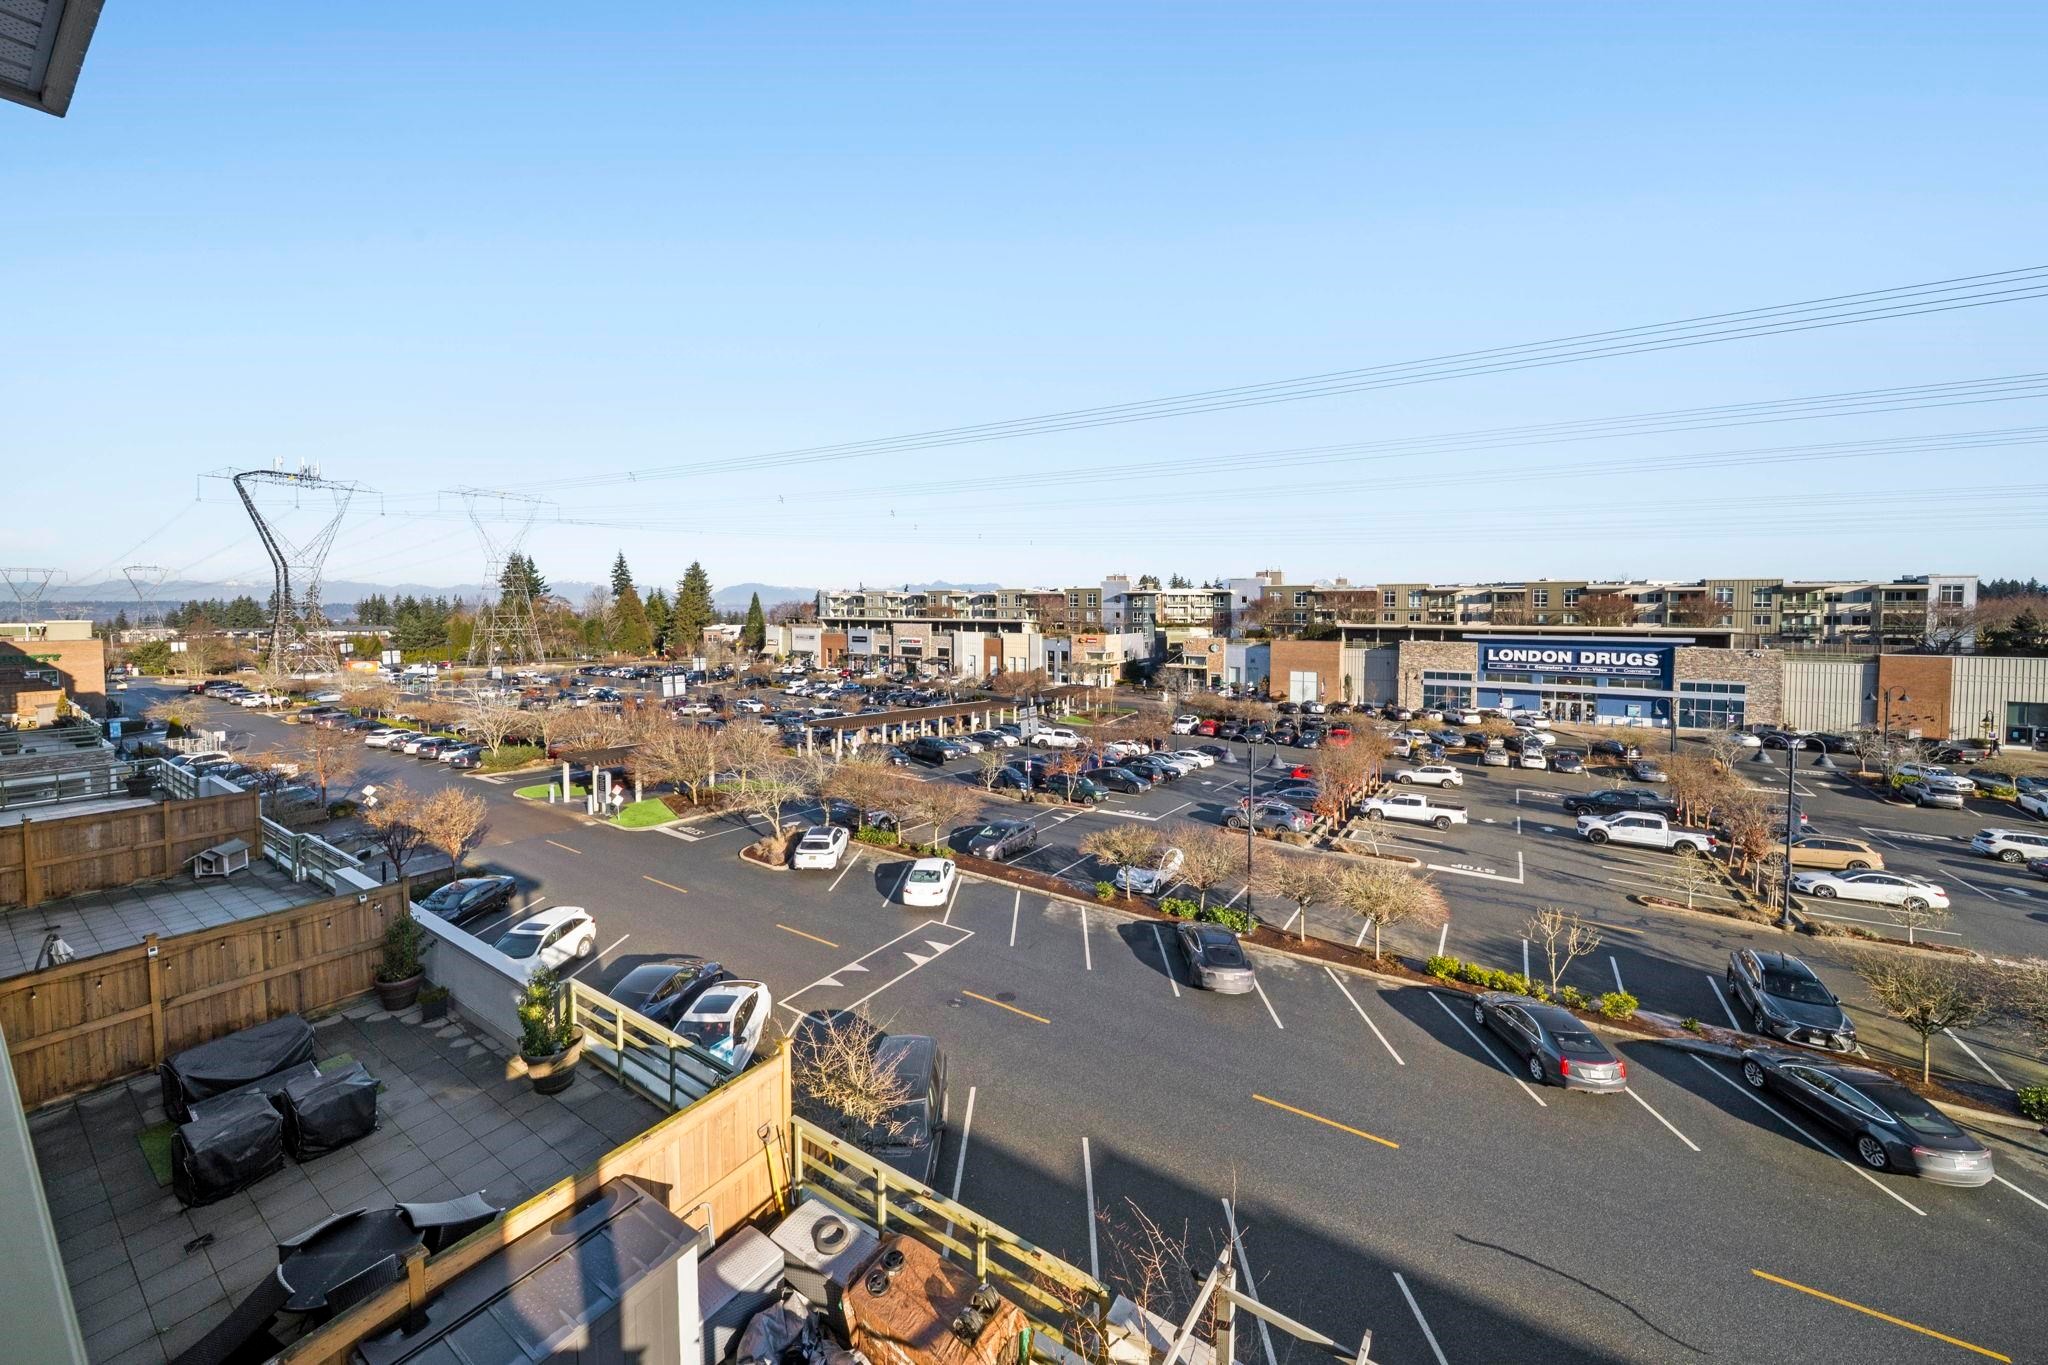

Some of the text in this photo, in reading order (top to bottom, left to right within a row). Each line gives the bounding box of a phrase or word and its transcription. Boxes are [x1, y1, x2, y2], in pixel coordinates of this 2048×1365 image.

[1488, 649, 1659, 667] LONDON DRUGS
[1451, 864, 1496, 875] STOP
